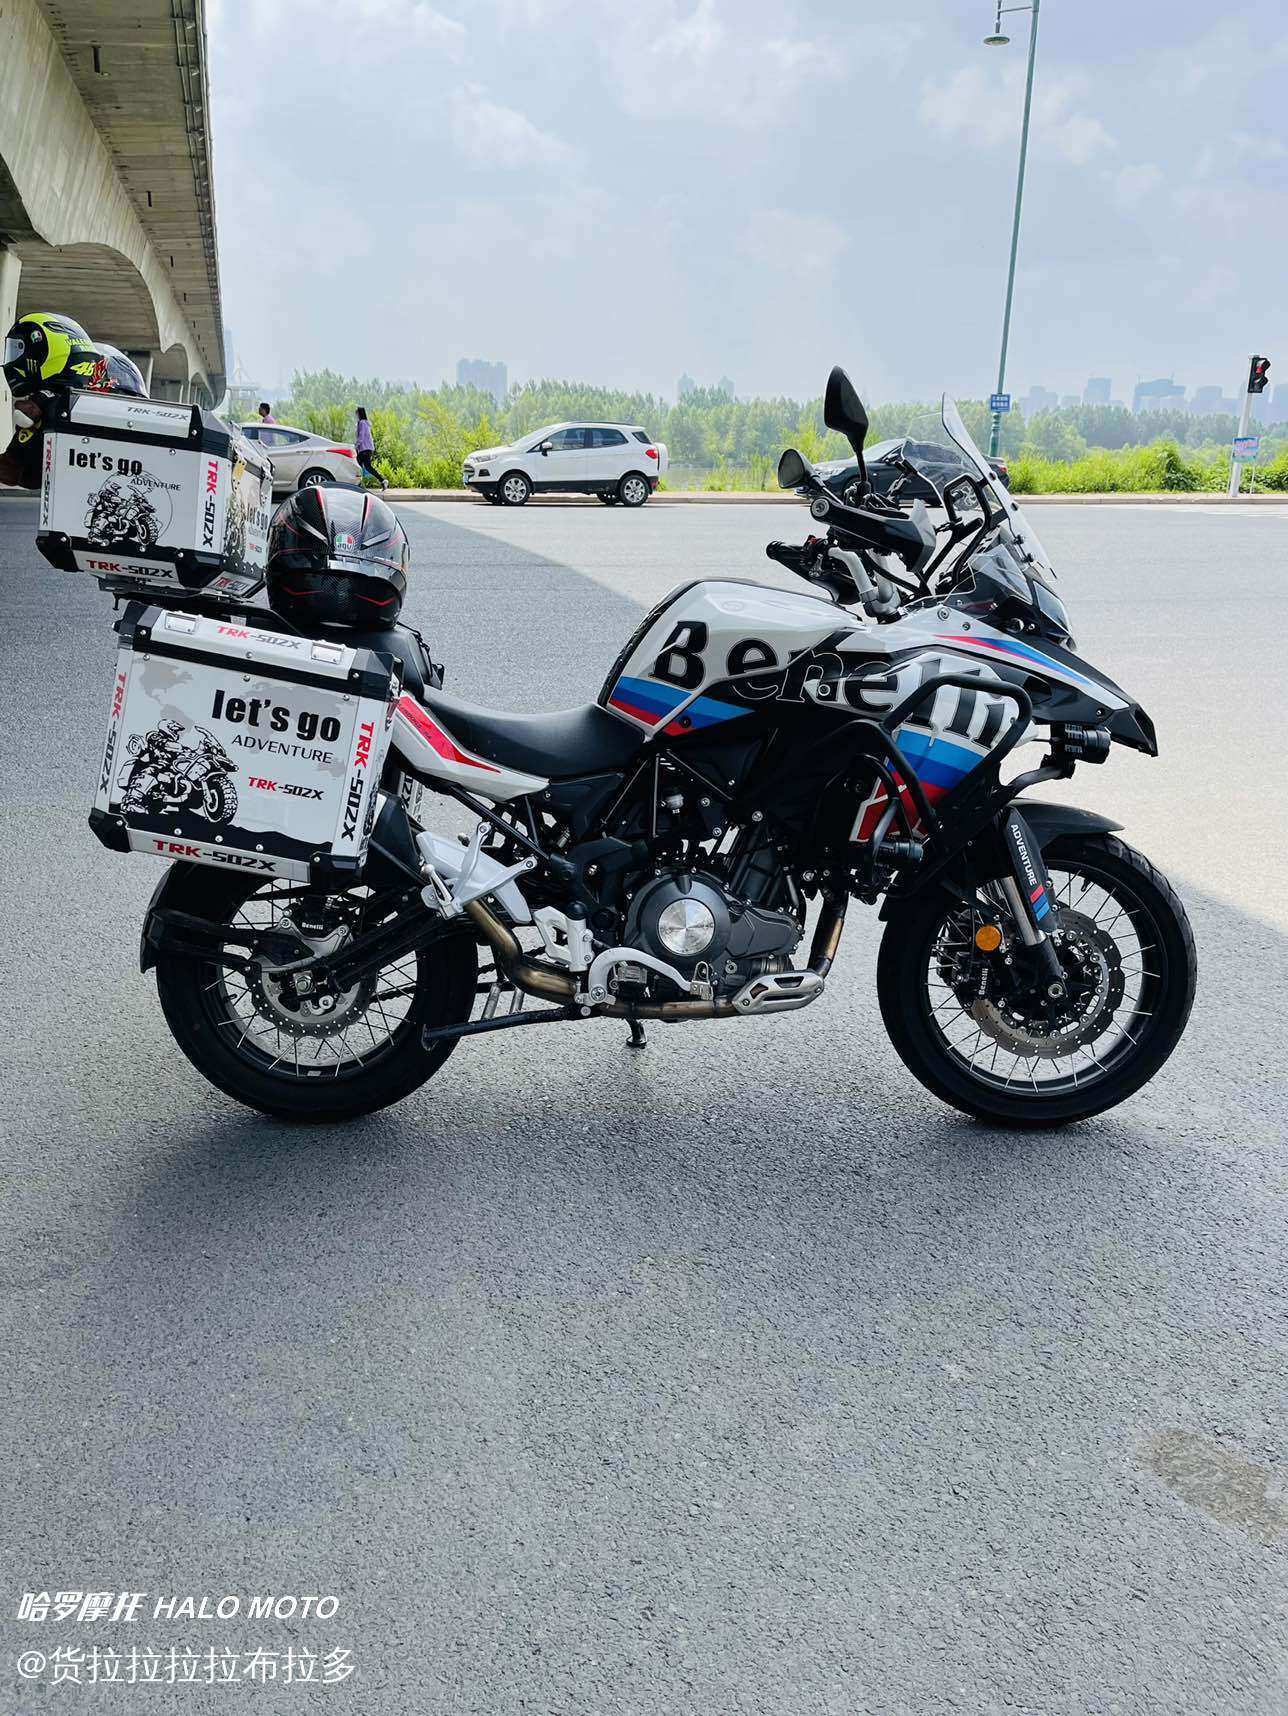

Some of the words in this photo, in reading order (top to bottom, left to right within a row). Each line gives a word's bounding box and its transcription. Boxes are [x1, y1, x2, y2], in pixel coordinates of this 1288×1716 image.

[127, 406, 191, 422] TRK-502X
[68, 448, 113, 471] let's
[117, 458, 143, 477] go
[130, 477, 181, 492] ADVENTURE
[202, 460, 219, 549] TRK-502X
[86, 559, 173, 579] TRK-502X
[216, 624, 303, 650] TRK-502X
[211, 688, 291, 733] let's
[296, 711, 341, 743] go
[99, 671, 127, 795] TRK-502X
[231, 734, 334, 765] ADVENTURE
[247, 776, 325, 801] TRK-502X
[341, 721, 375, 842] TRK-502X
[153, 838, 277, 873] TRK-502X
[1010, 823, 1038, 887] ADVENTURE
